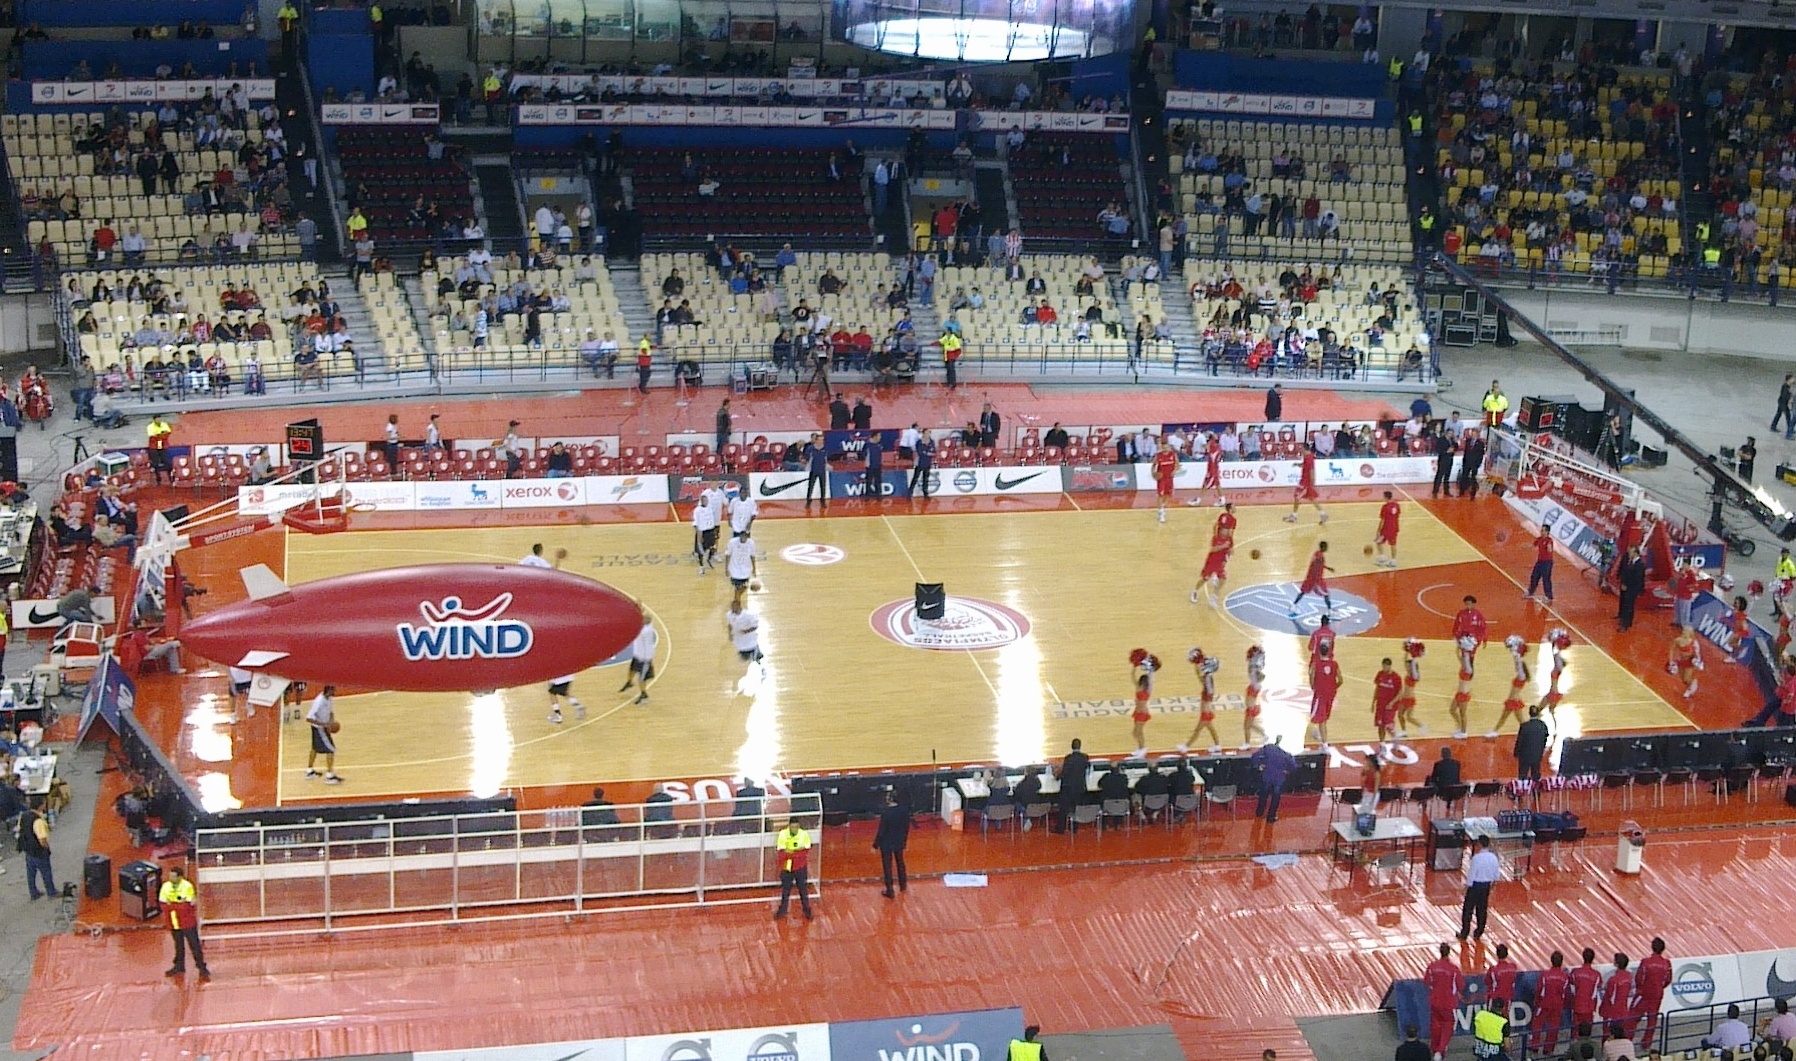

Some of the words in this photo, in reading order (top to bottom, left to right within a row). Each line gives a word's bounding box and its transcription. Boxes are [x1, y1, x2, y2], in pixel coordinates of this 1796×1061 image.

[506, 485, 552, 498] xerox
[398, 621, 533, 660] WIND
[1673, 982, 1711, 991] VOLVO
[879, 1043, 980, 1061] WIND
